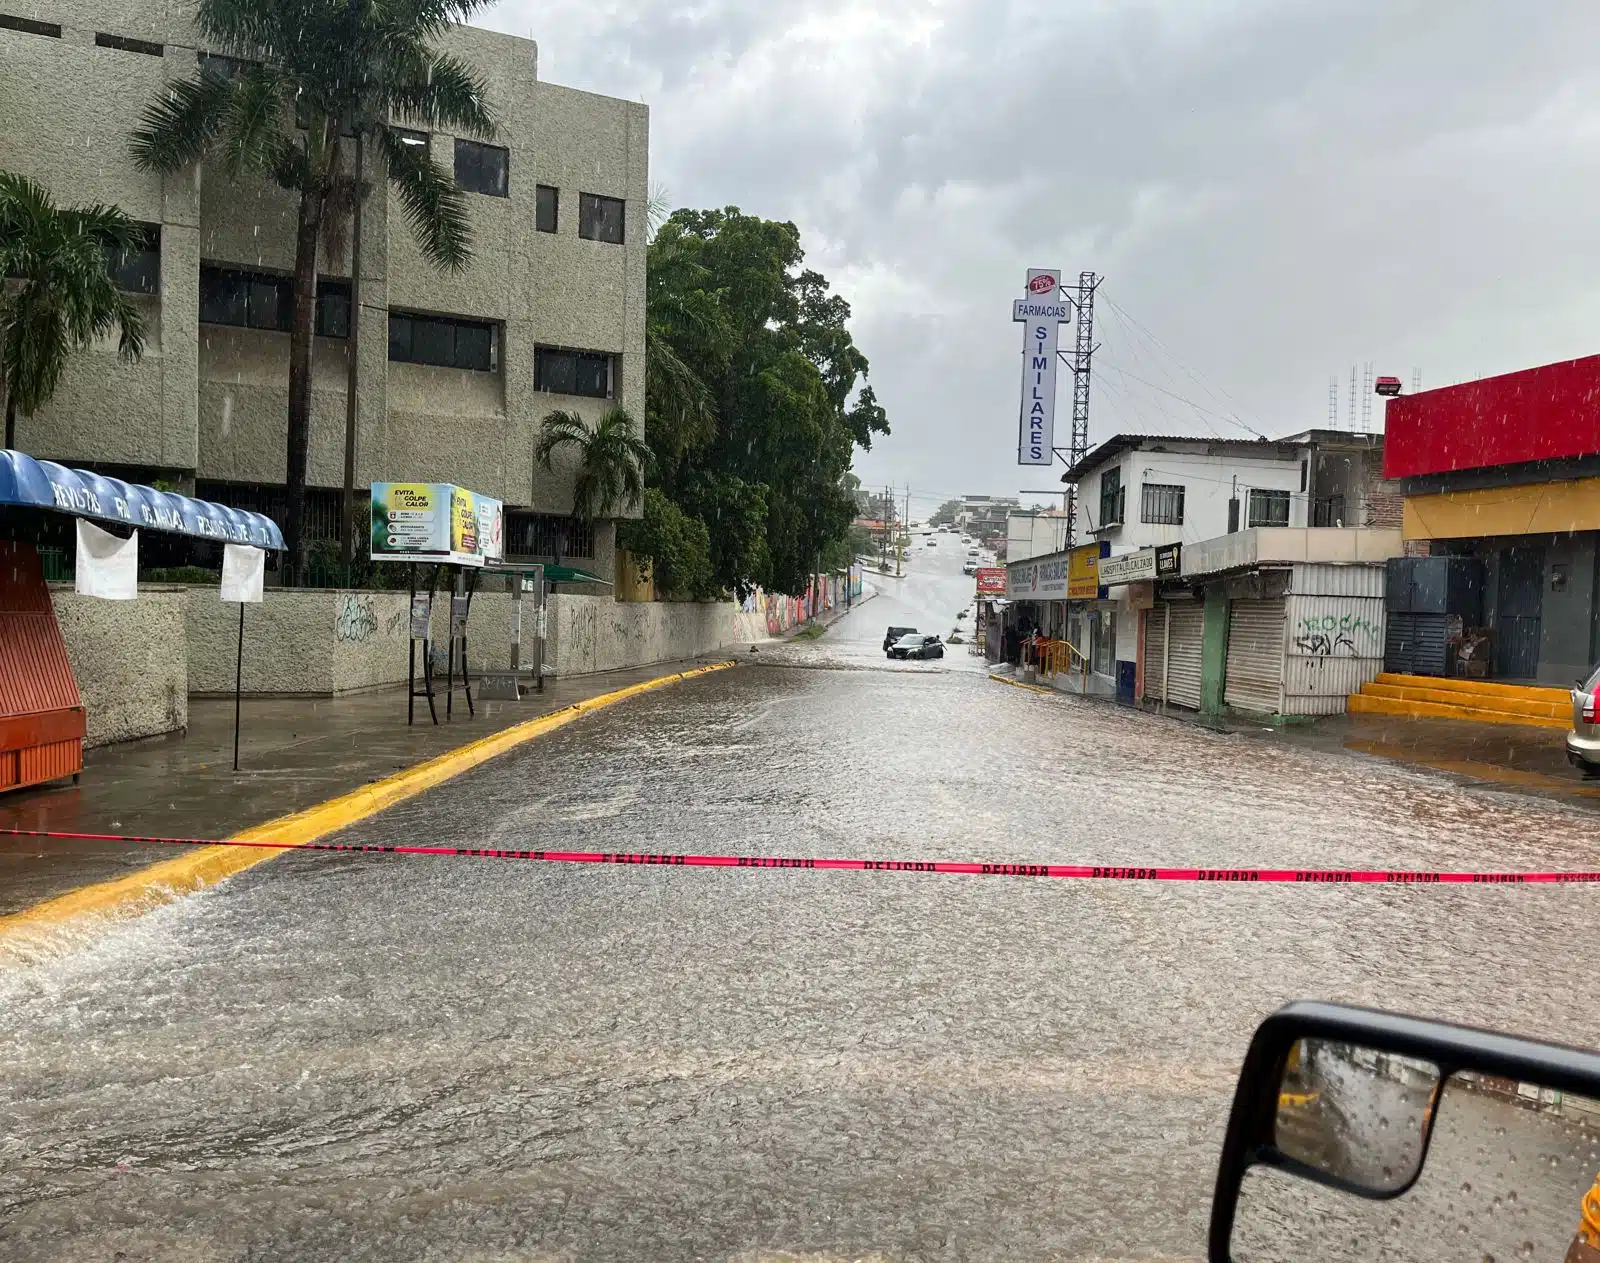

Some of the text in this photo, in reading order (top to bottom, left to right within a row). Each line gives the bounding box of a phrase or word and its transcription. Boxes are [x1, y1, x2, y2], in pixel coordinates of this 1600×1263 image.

[1033, 277, 1052, 290] 75%
[1018, 304, 1066, 317] FARMACIAS
[1030, 326, 1047, 460] SIMILARES
[53, 481, 102, 514] REVISTAS
[457, 497, 467, 508] EVITA
[1131, 557, 1153, 570] CALZADO
